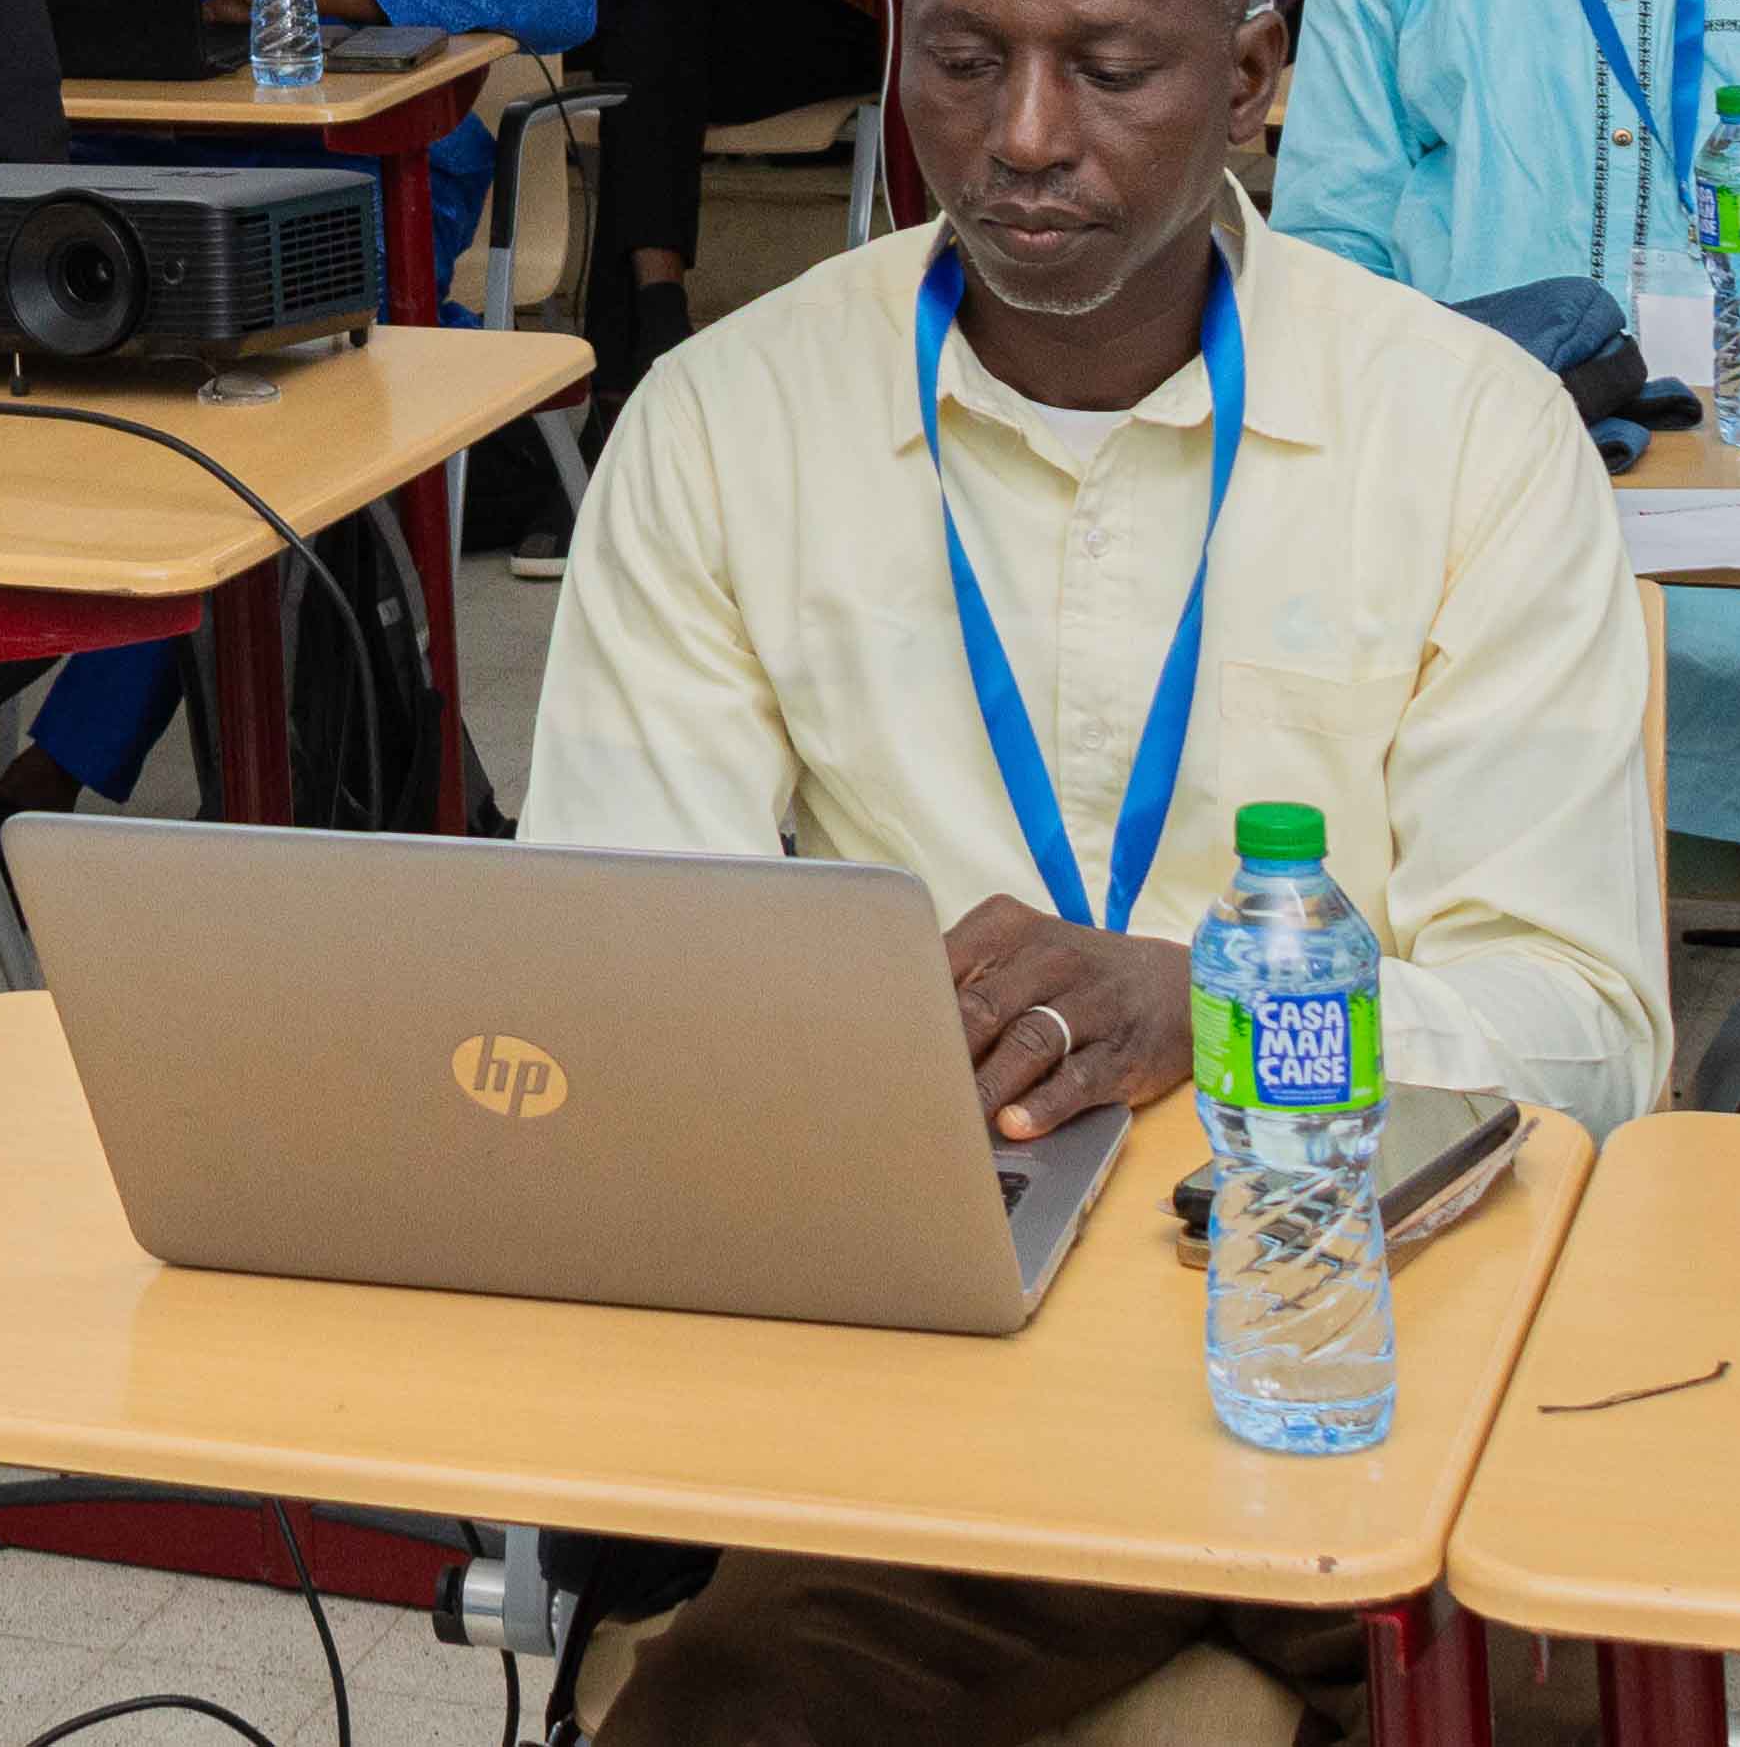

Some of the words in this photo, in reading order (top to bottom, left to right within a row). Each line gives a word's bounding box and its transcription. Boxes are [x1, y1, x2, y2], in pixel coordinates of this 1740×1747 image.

[1255, 1000, 1344, 1030] CASA
[1259, 1028, 1344, 1057] MAN
[462, 1034, 560, 1118] hp
